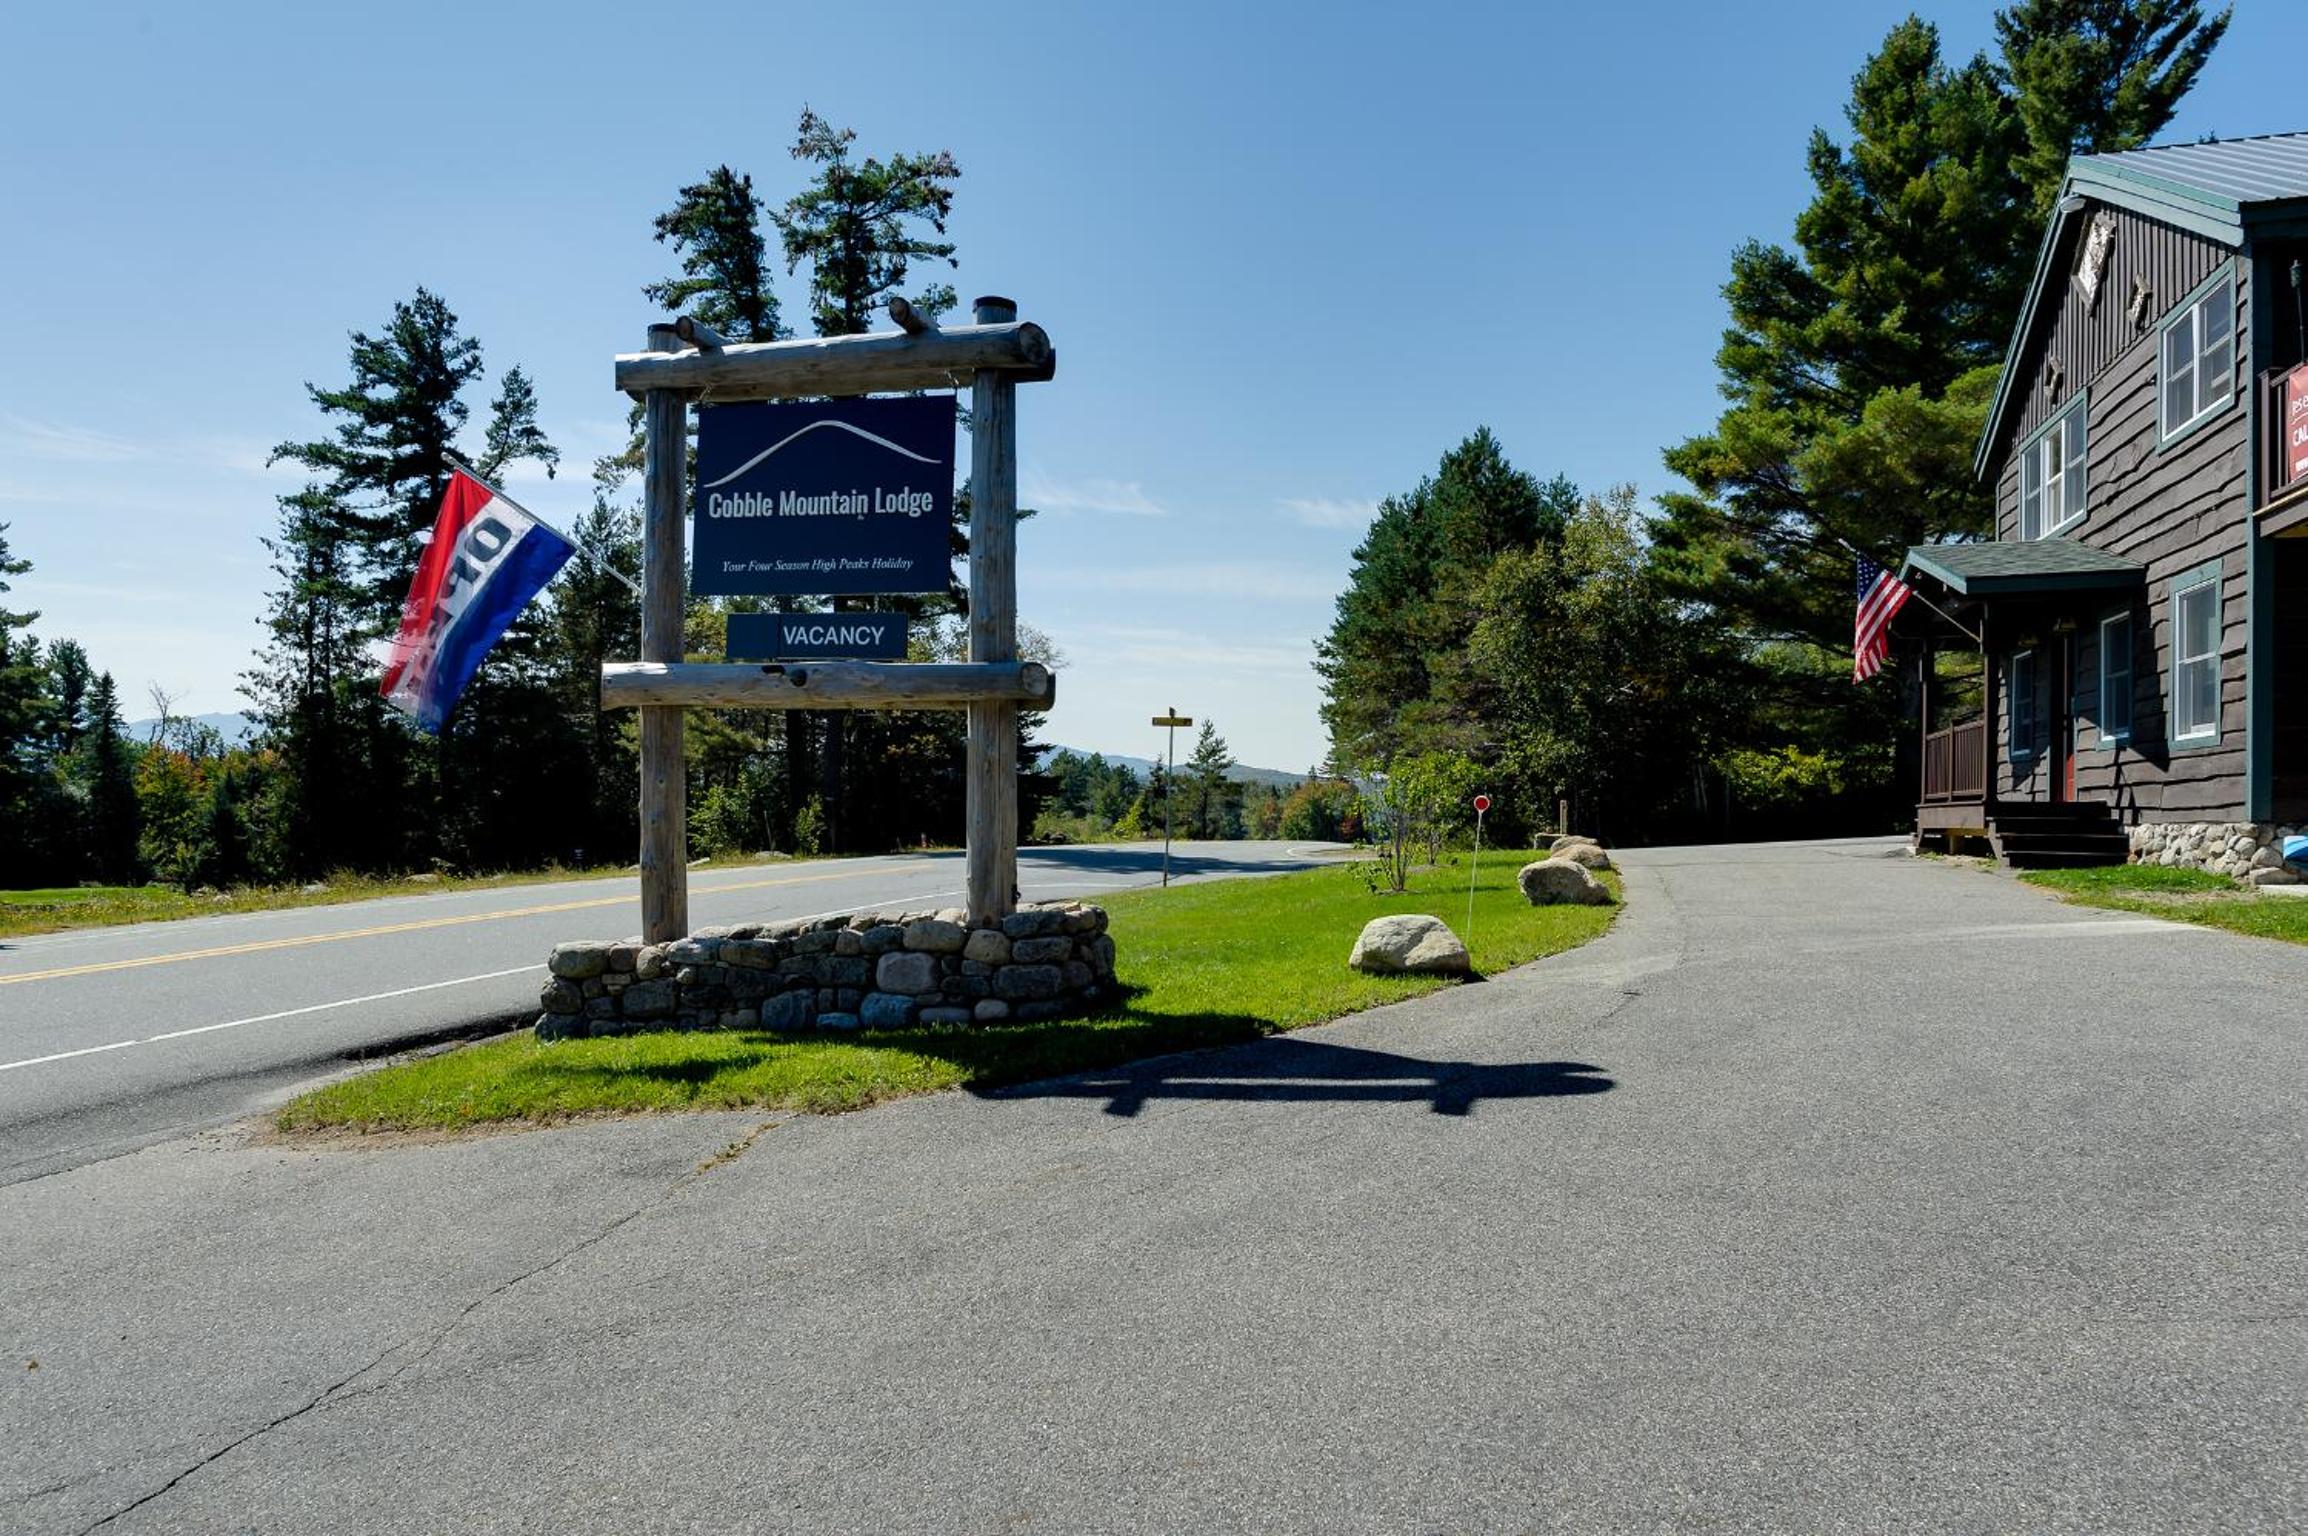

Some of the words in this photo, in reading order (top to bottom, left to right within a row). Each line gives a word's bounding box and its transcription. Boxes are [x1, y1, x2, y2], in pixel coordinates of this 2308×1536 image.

[709, 491, 773, 518] Cobble
[779, 490, 869, 517] Mountain
[875, 486, 933, 517] Lodge
[723, 561, 747, 573] Your
[747, 560, 773, 572] Four
[774, 559, 810, 571] Season
[811, 558, 836, 573] High
[839, 557, 870, 570] Peaks
[871, 557, 914, 572] Holiday
[783, 625, 885, 645] VACANCY
